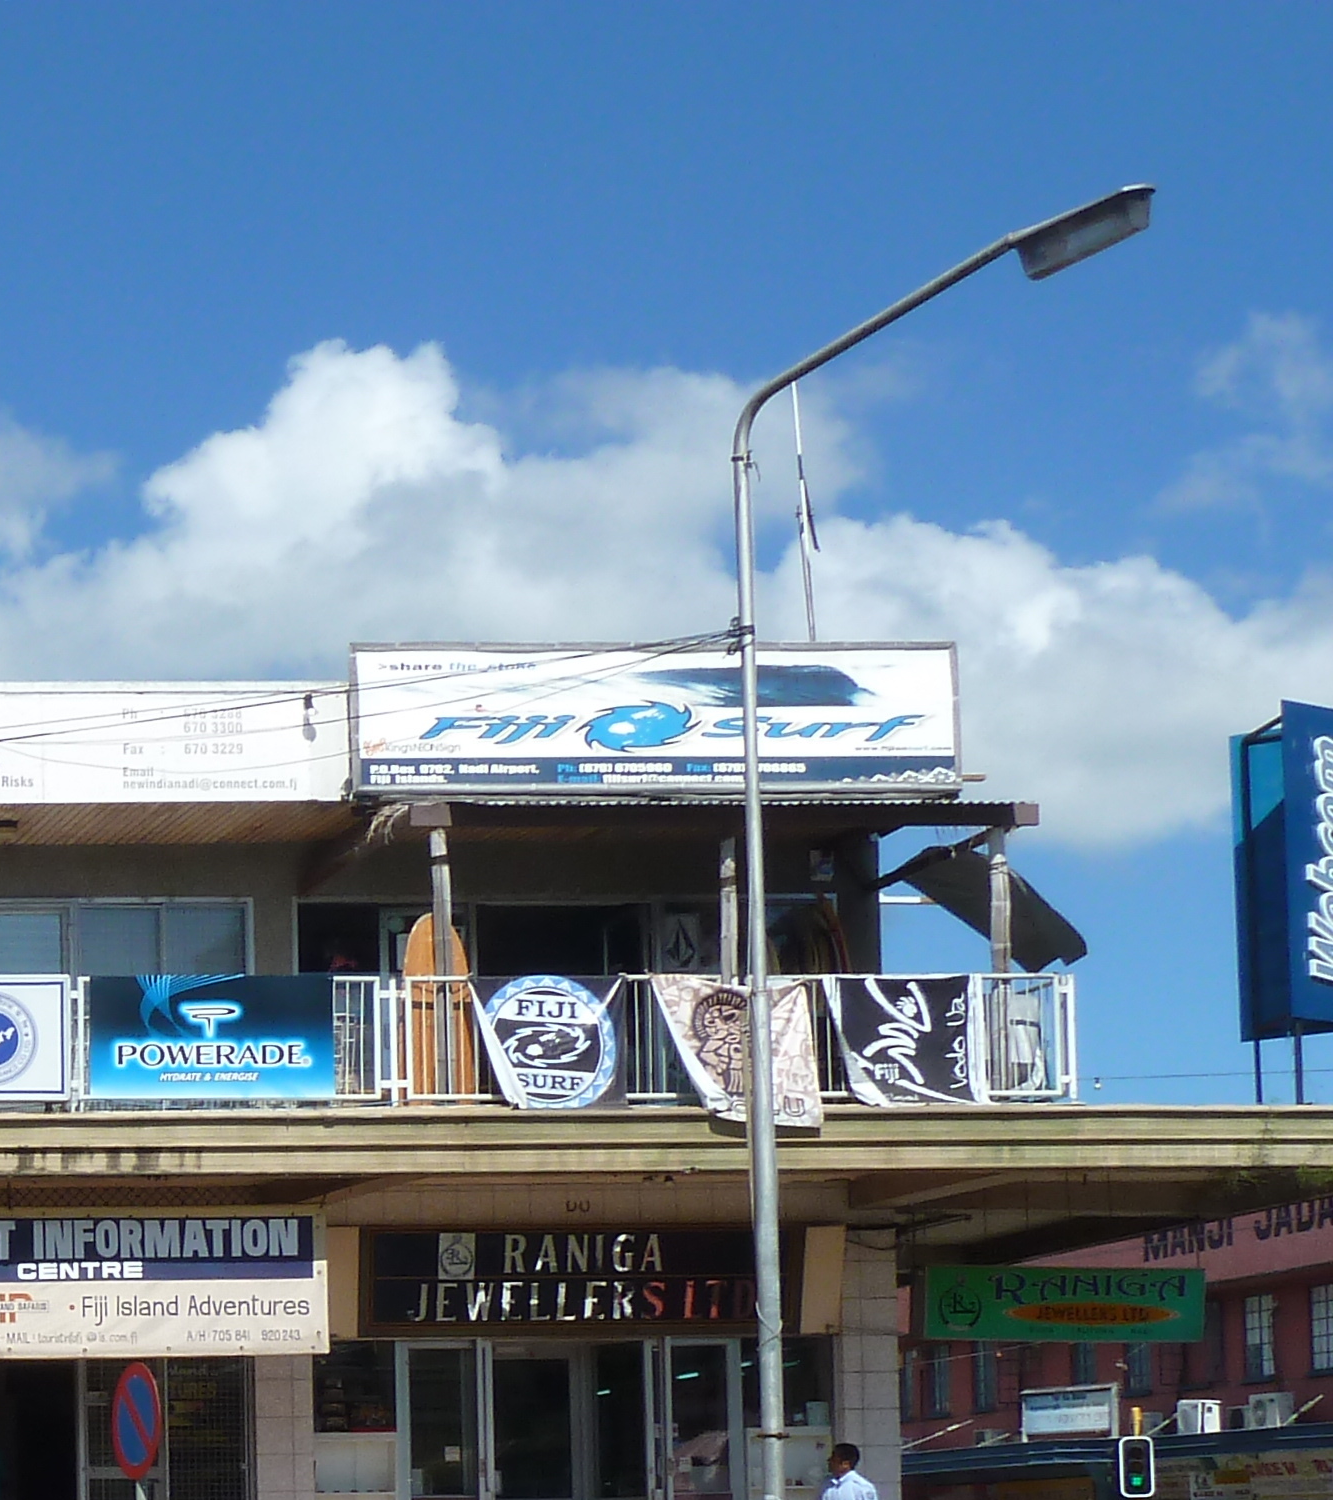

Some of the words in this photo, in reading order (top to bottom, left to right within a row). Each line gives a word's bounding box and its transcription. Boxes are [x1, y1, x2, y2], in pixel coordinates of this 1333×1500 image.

[418, 714, 576, 744] Fiji
[701, 713, 926, 742] Surf
[122, 742, 144, 756] Fax
[183, 743, 209, 756] 670
[210, 743, 244, 756] 3229
[0, 775, 35, 790] Risks
[122, 767, 155, 778] Email
[515, 998, 579, 1020] FIJI
[115, 1043, 305, 1068] POWERADE
[517, 1072, 585, 1091] SURF
[873, 1063, 901, 1085] Fiji
[33, 1218, 300, 1261] INFORMATION
[1143, 1217, 1233, 1263] MANJI
[503, 1233, 665, 1275] RANIGA
[16, 1260, 145, 1281] CENTRE
[988, 1271, 1188, 1305] RANIGA
[81, 1295, 109, 1327] Fiji
[116, 1295, 180, 1318] Island
[187, 1294, 311, 1318] Adventures
[408, 1281, 669, 1322] JEWELLERS
[682, 1279, 757, 1319] LTD
[1035, 1305, 1117, 1323] JEWELLERS
[1121, 1307, 1149, 1321] LTD
